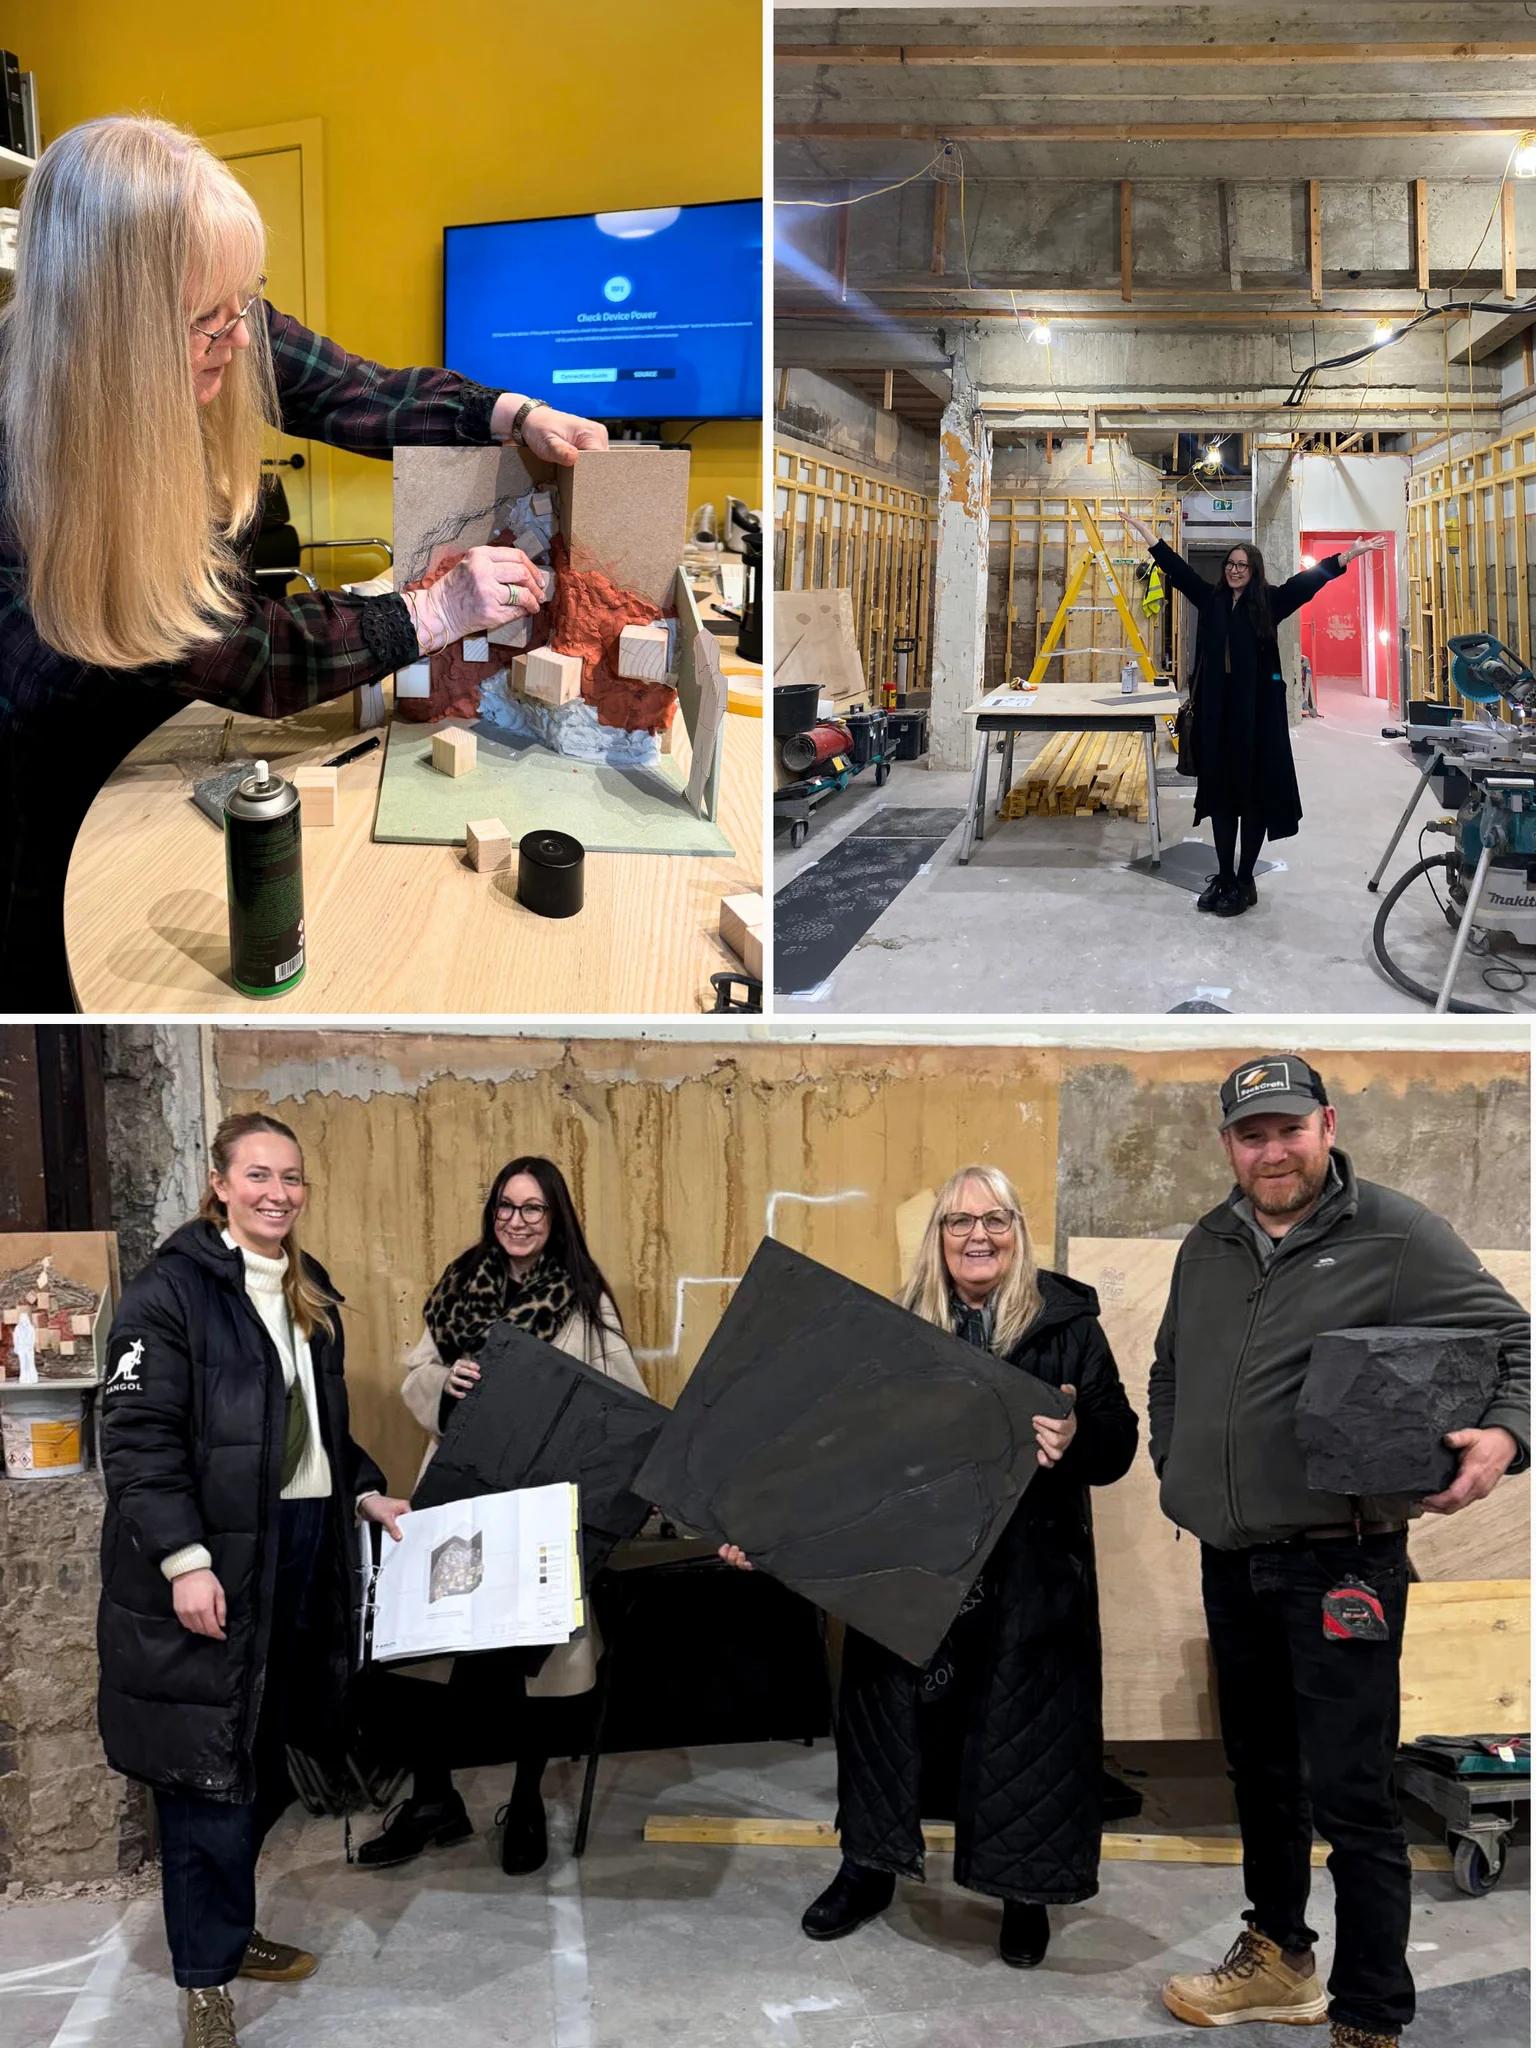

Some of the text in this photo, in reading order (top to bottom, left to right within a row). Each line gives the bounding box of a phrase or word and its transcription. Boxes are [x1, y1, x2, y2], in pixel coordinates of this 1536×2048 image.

[577, 310, 657, 323] Check Device Power
[1488, 892, 1536, 907] makit
